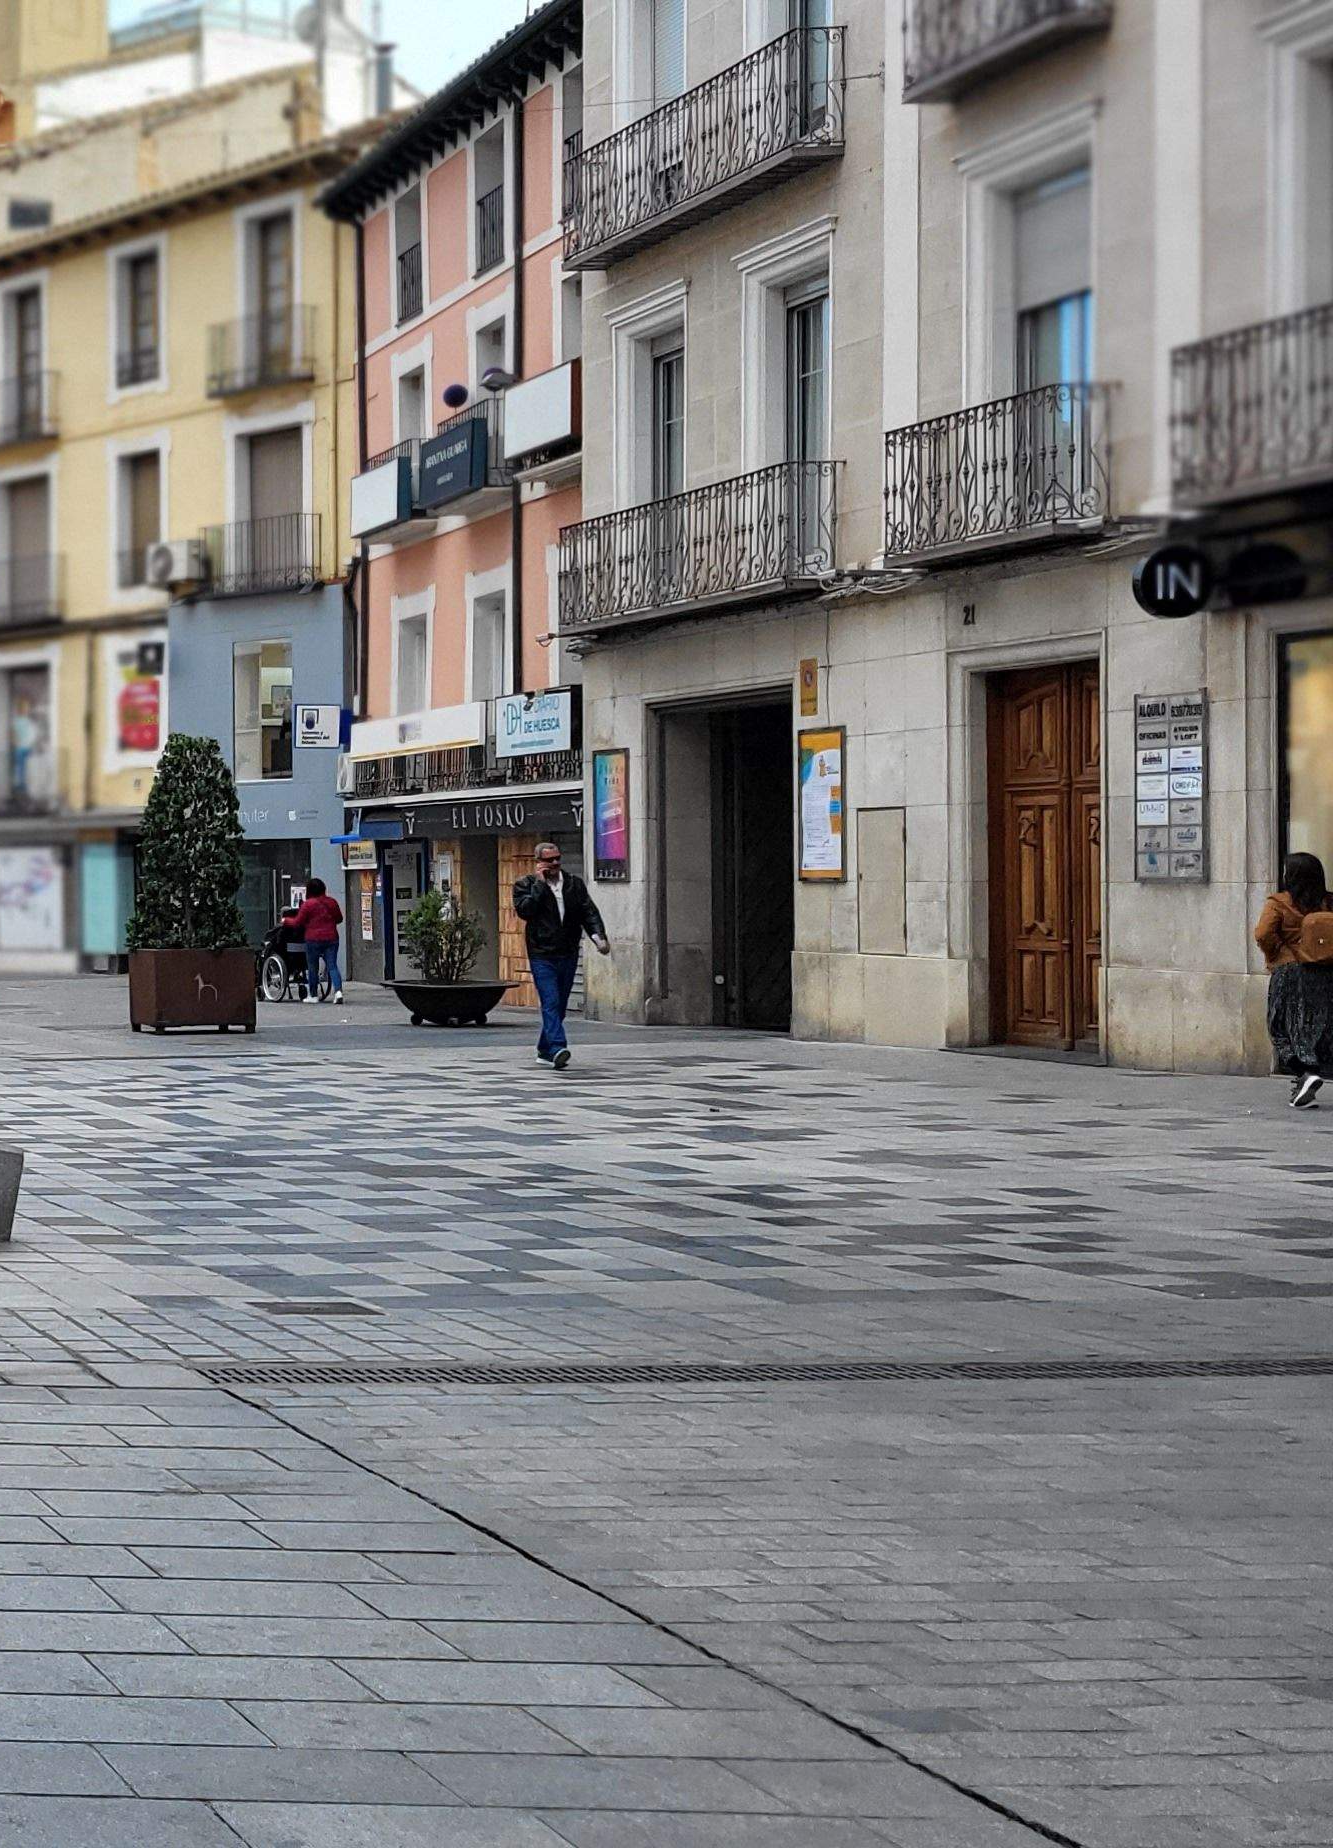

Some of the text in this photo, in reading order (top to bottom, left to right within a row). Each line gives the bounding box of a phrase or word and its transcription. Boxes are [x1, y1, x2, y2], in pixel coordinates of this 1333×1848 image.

[1156, 562, 1201, 601] IN
[963, 604, 976, 626] 21
[1139, 702, 1166, 717] ALQUILO
[452, 802, 525, 829] EL FOSKO
